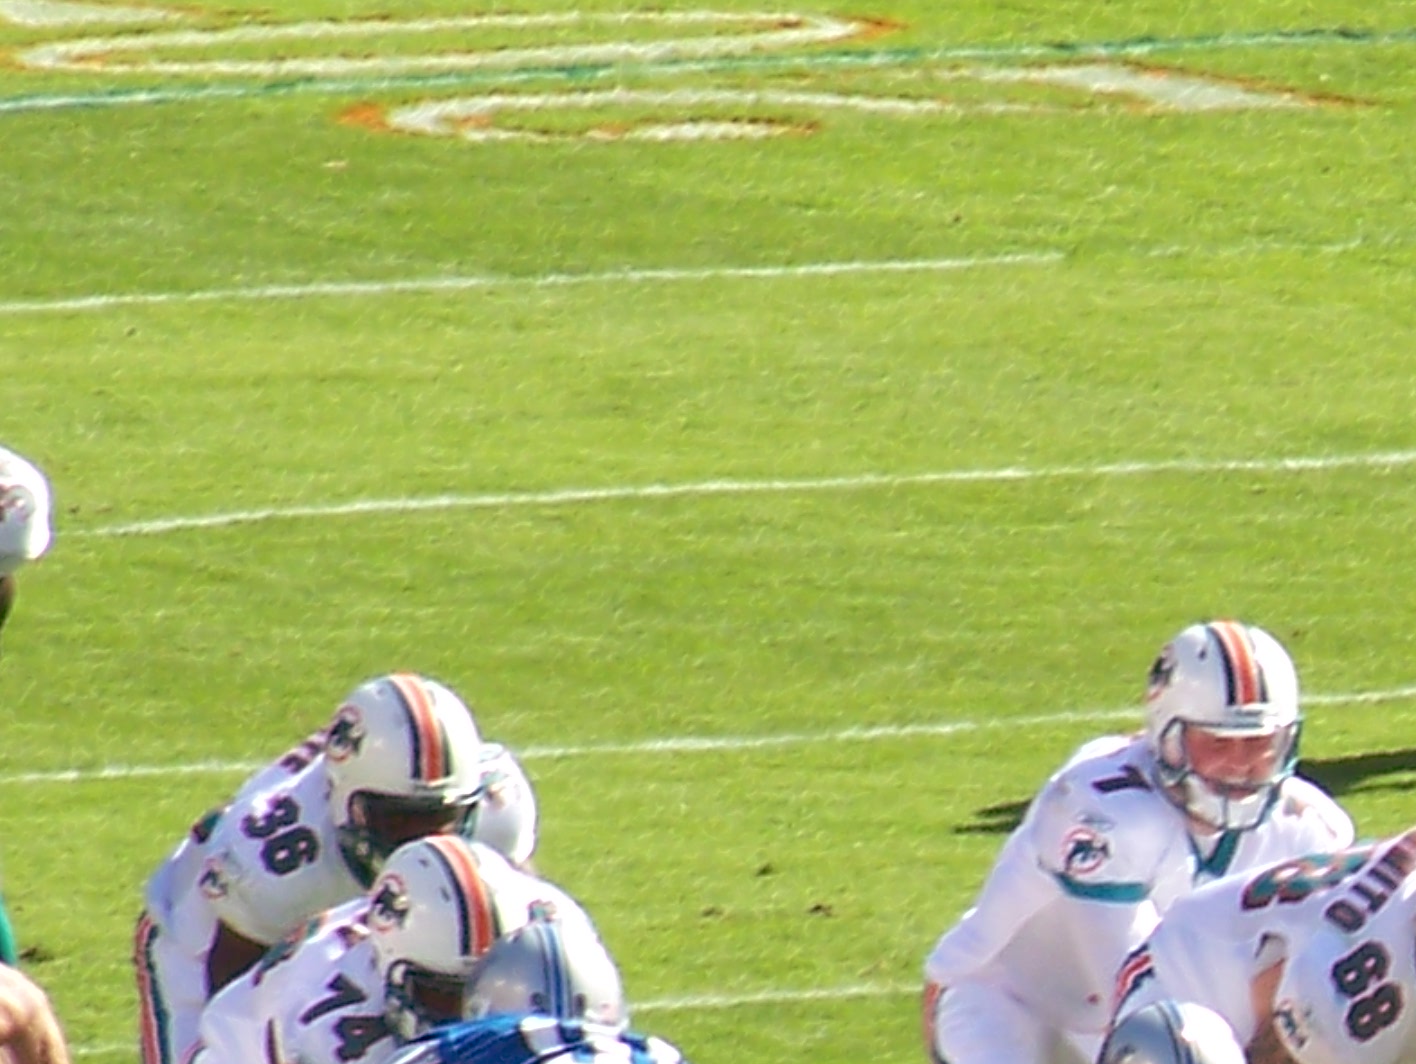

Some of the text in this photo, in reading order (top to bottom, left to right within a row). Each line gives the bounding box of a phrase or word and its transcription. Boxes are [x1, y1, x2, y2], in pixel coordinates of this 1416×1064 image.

[240, 795, 320, 876] 36
[299, 973, 395, 1063] 74
[1329, 940, 1405, 1044] 68
